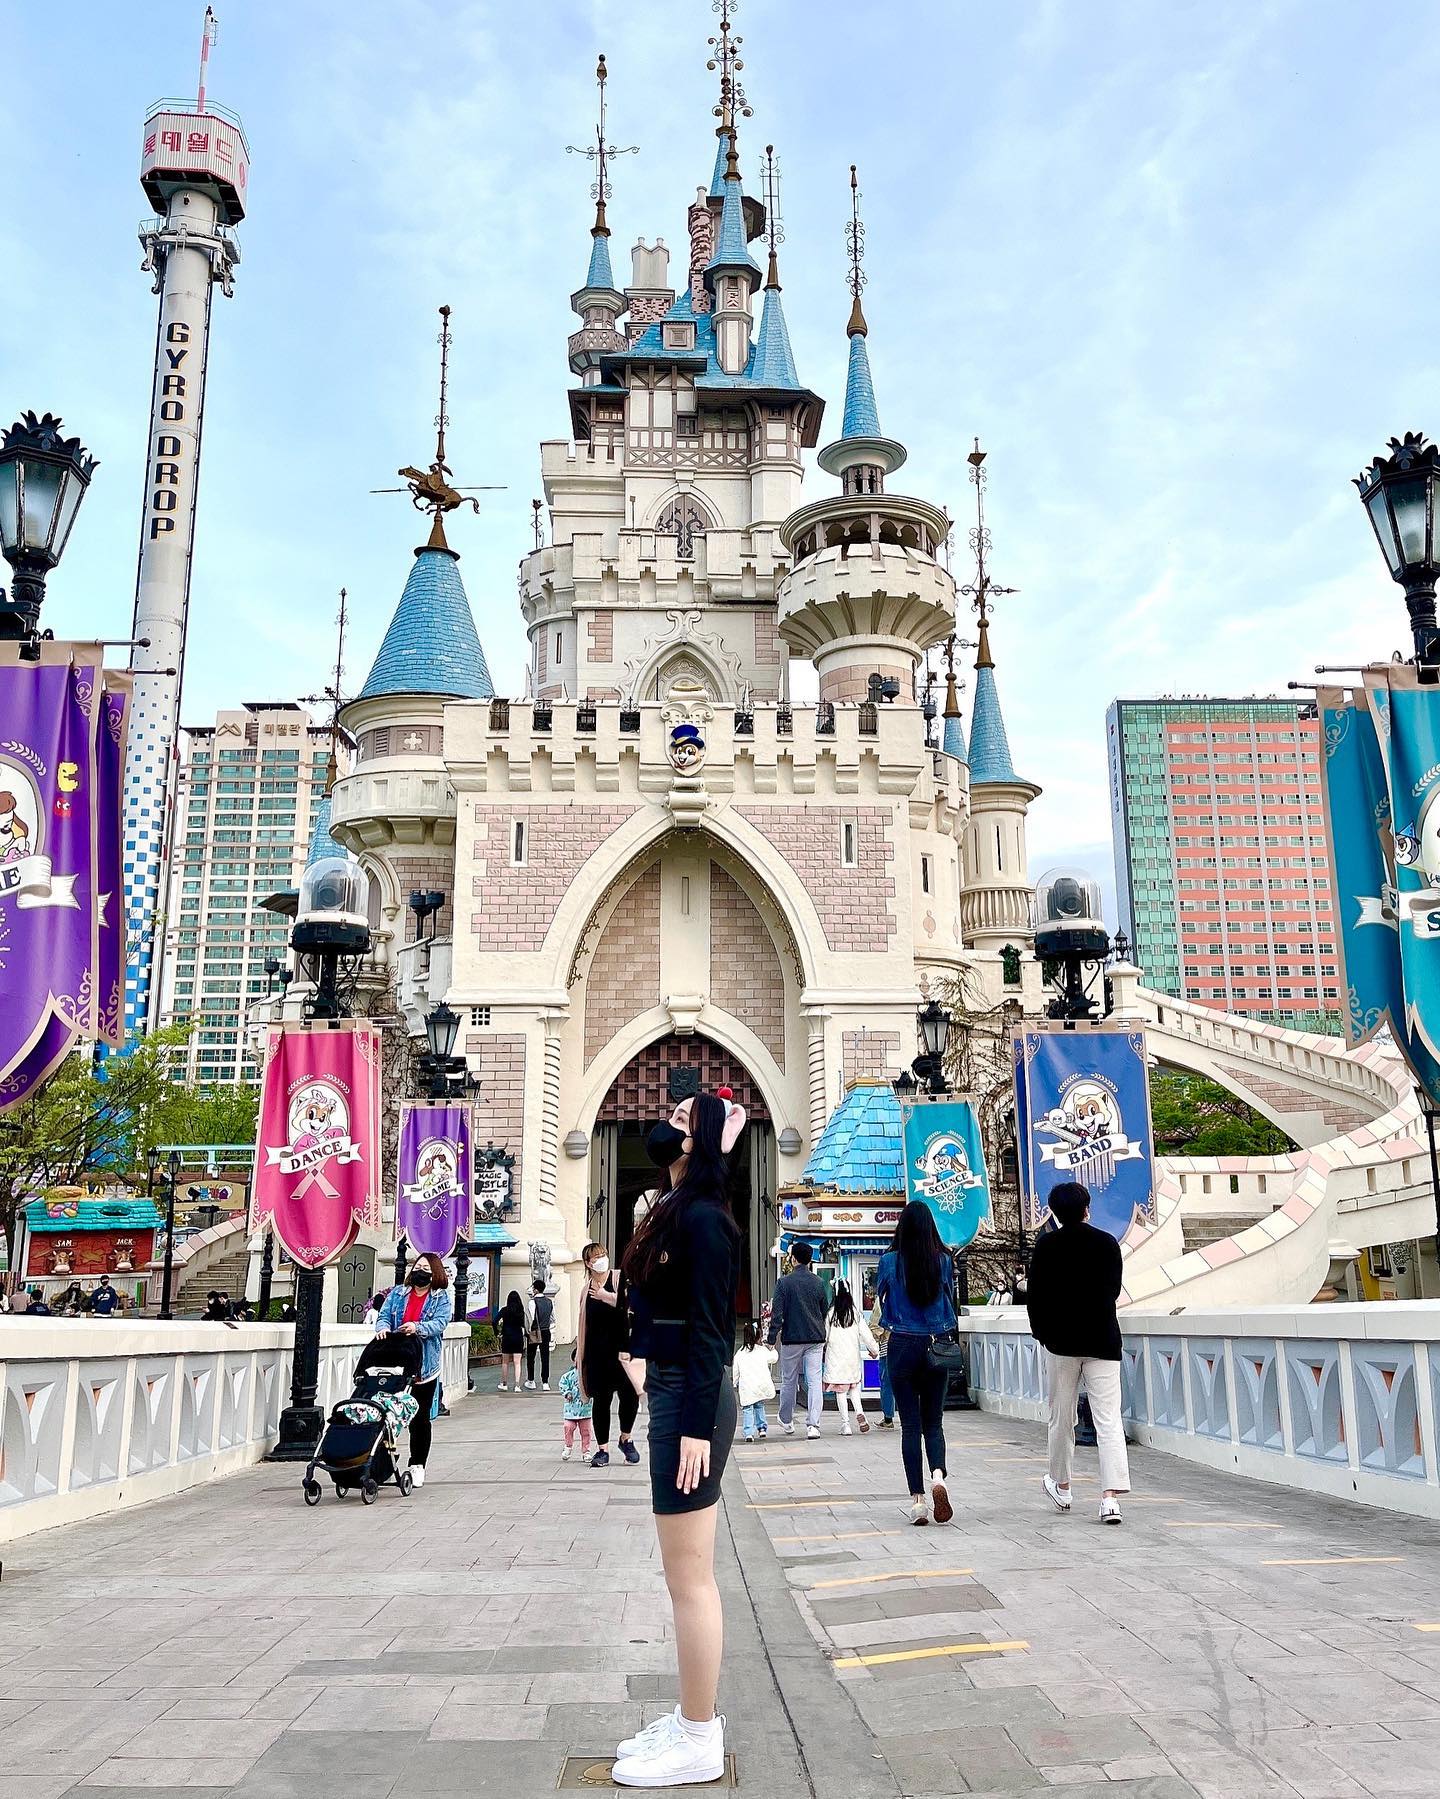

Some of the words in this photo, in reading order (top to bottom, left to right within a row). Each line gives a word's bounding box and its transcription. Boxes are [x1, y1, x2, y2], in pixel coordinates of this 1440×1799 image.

[144, 131, 233, 165] 롯데월드
[160, 322, 191, 422] GYRO
[150, 436, 182, 541] DROP
[290, 1141, 342, 1170] DANCE
[1068, 1138, 1112, 1165] BAND
[478, 1172, 502, 1180] MAGIC
[928, 1172, 969, 1194] SCIENCE
[423, 1181, 451, 1199] GAME
[55, 1239, 73, 1247] SAM
